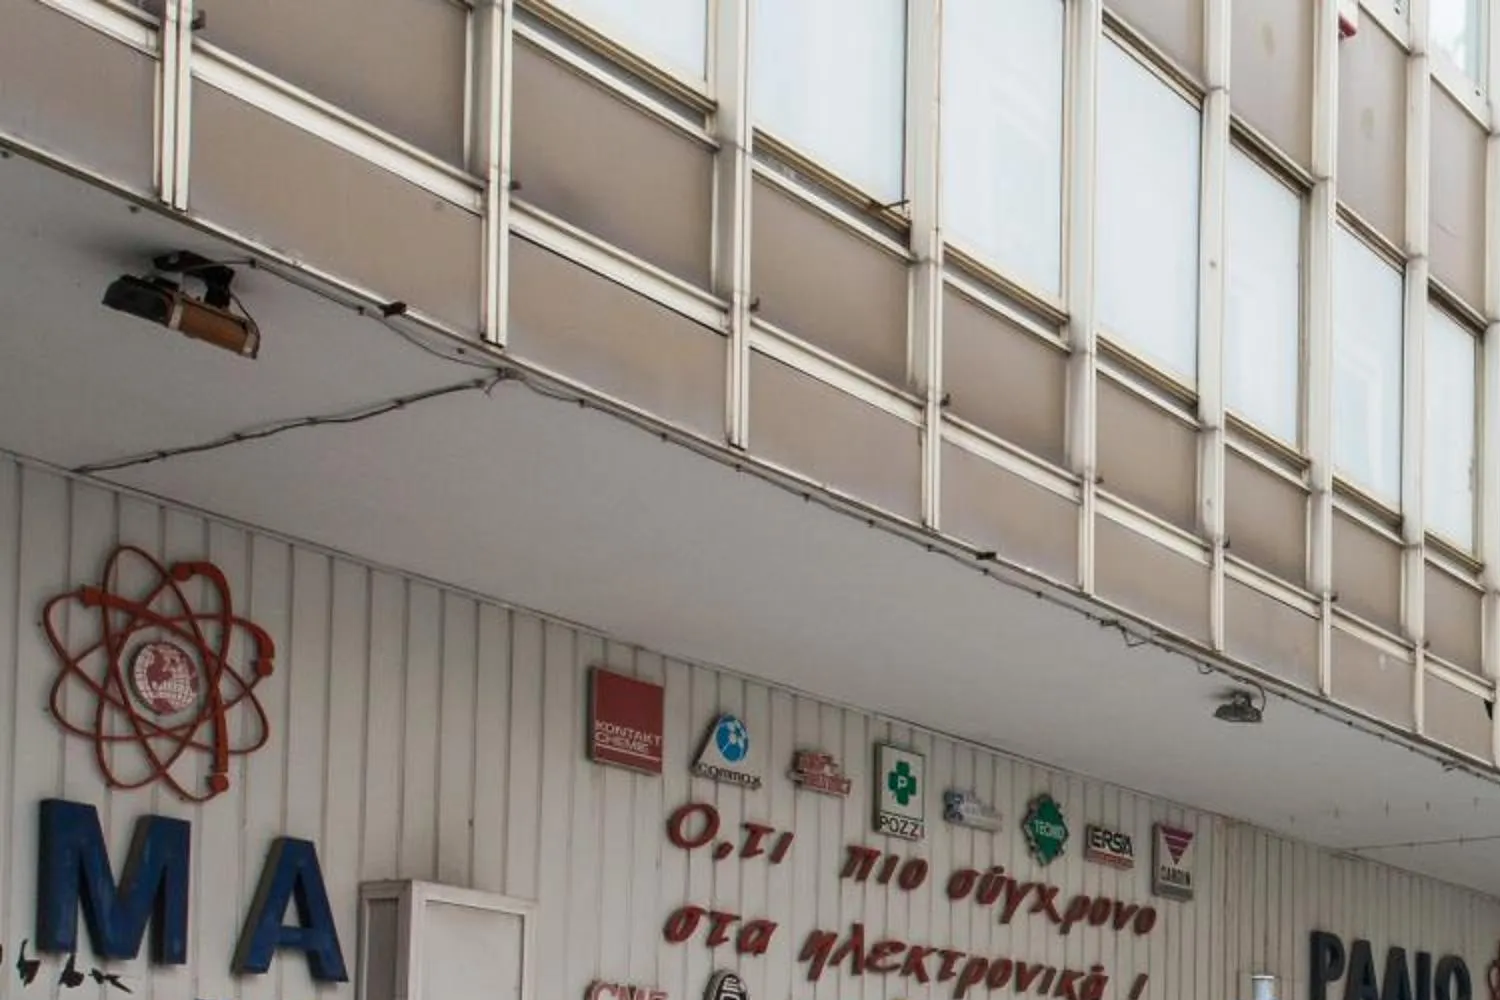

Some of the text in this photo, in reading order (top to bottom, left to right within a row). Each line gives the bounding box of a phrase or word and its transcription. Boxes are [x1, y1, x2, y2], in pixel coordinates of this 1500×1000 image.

[879, 814, 924, 839] POZZI
[839, 845, 929, 891] πιο
[946, 866, 1158, 936] σύγχρονο
[663, 905, 778, 956] στα
